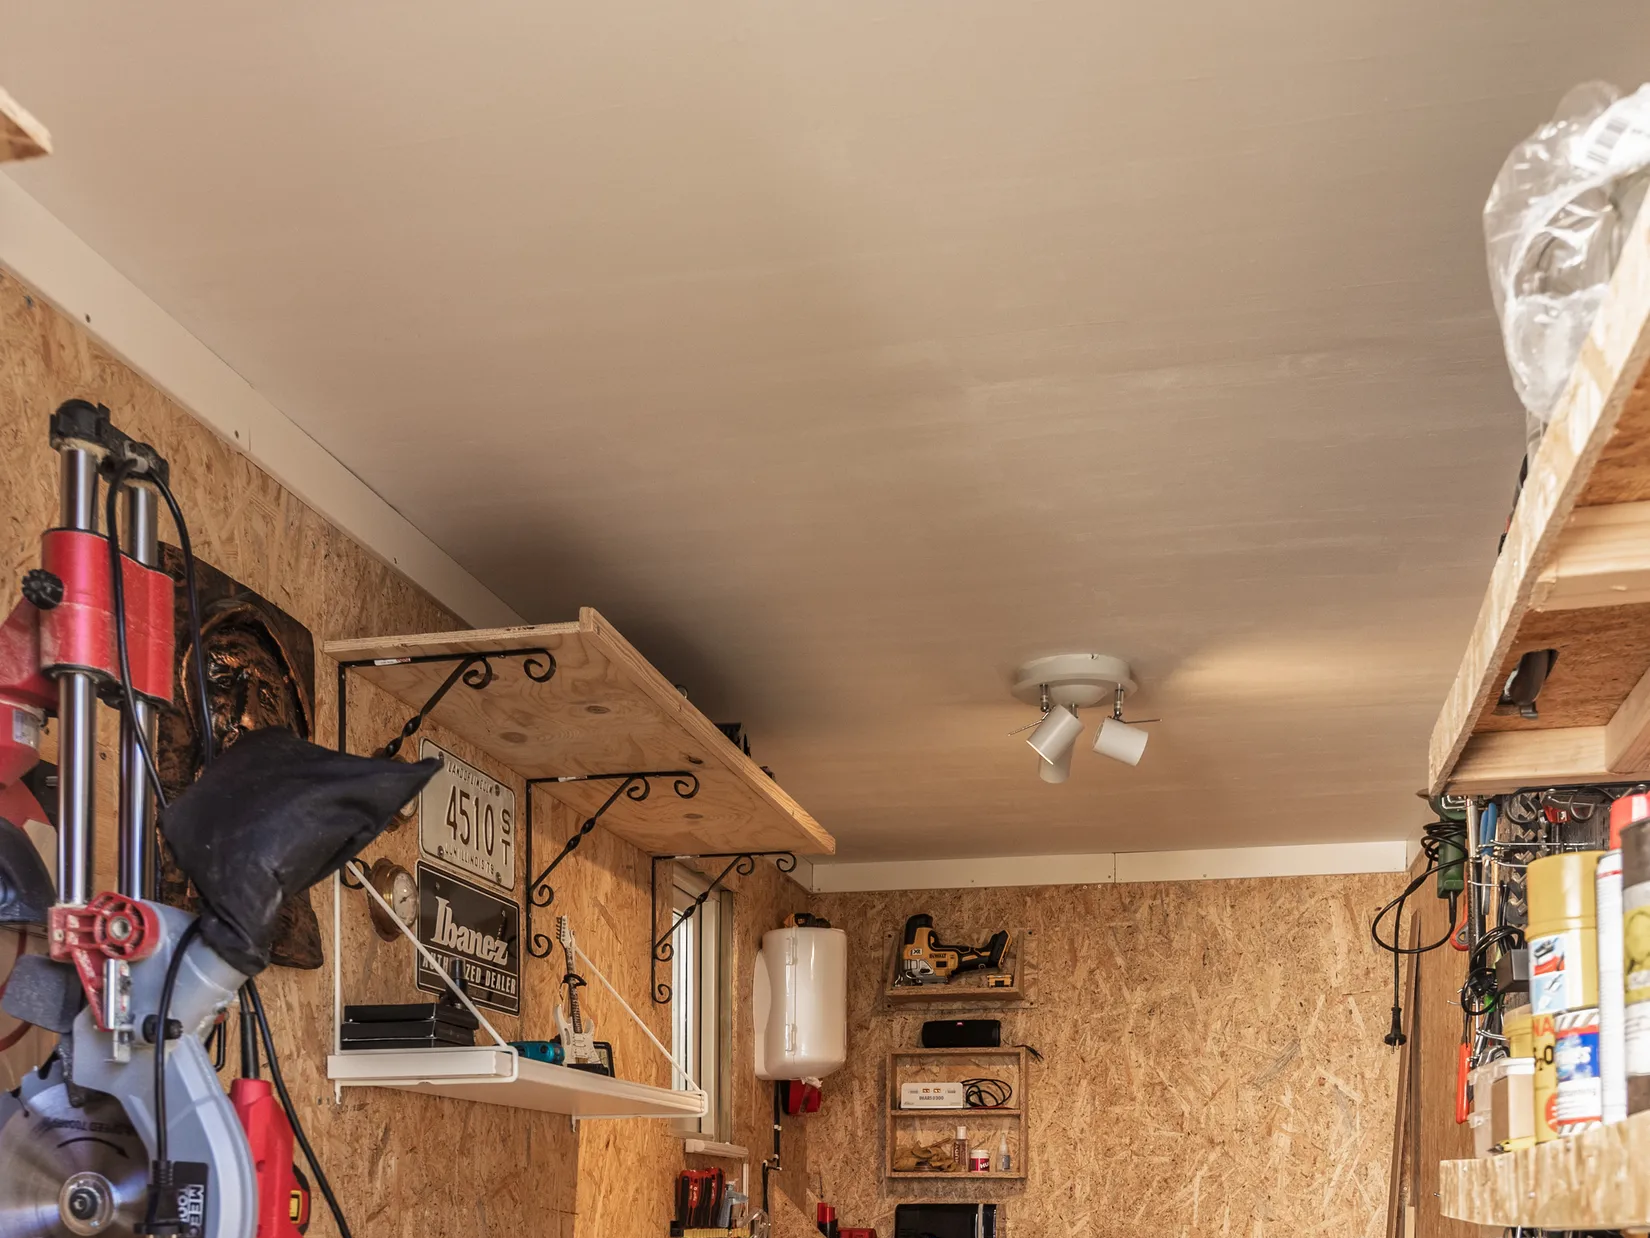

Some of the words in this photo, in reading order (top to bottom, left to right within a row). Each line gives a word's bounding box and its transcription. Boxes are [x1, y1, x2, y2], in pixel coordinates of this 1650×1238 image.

[445, 785, 494, 856] 4510
[430, 896, 509, 965] Ibanez
[485, 970, 516, 994] DEALER
